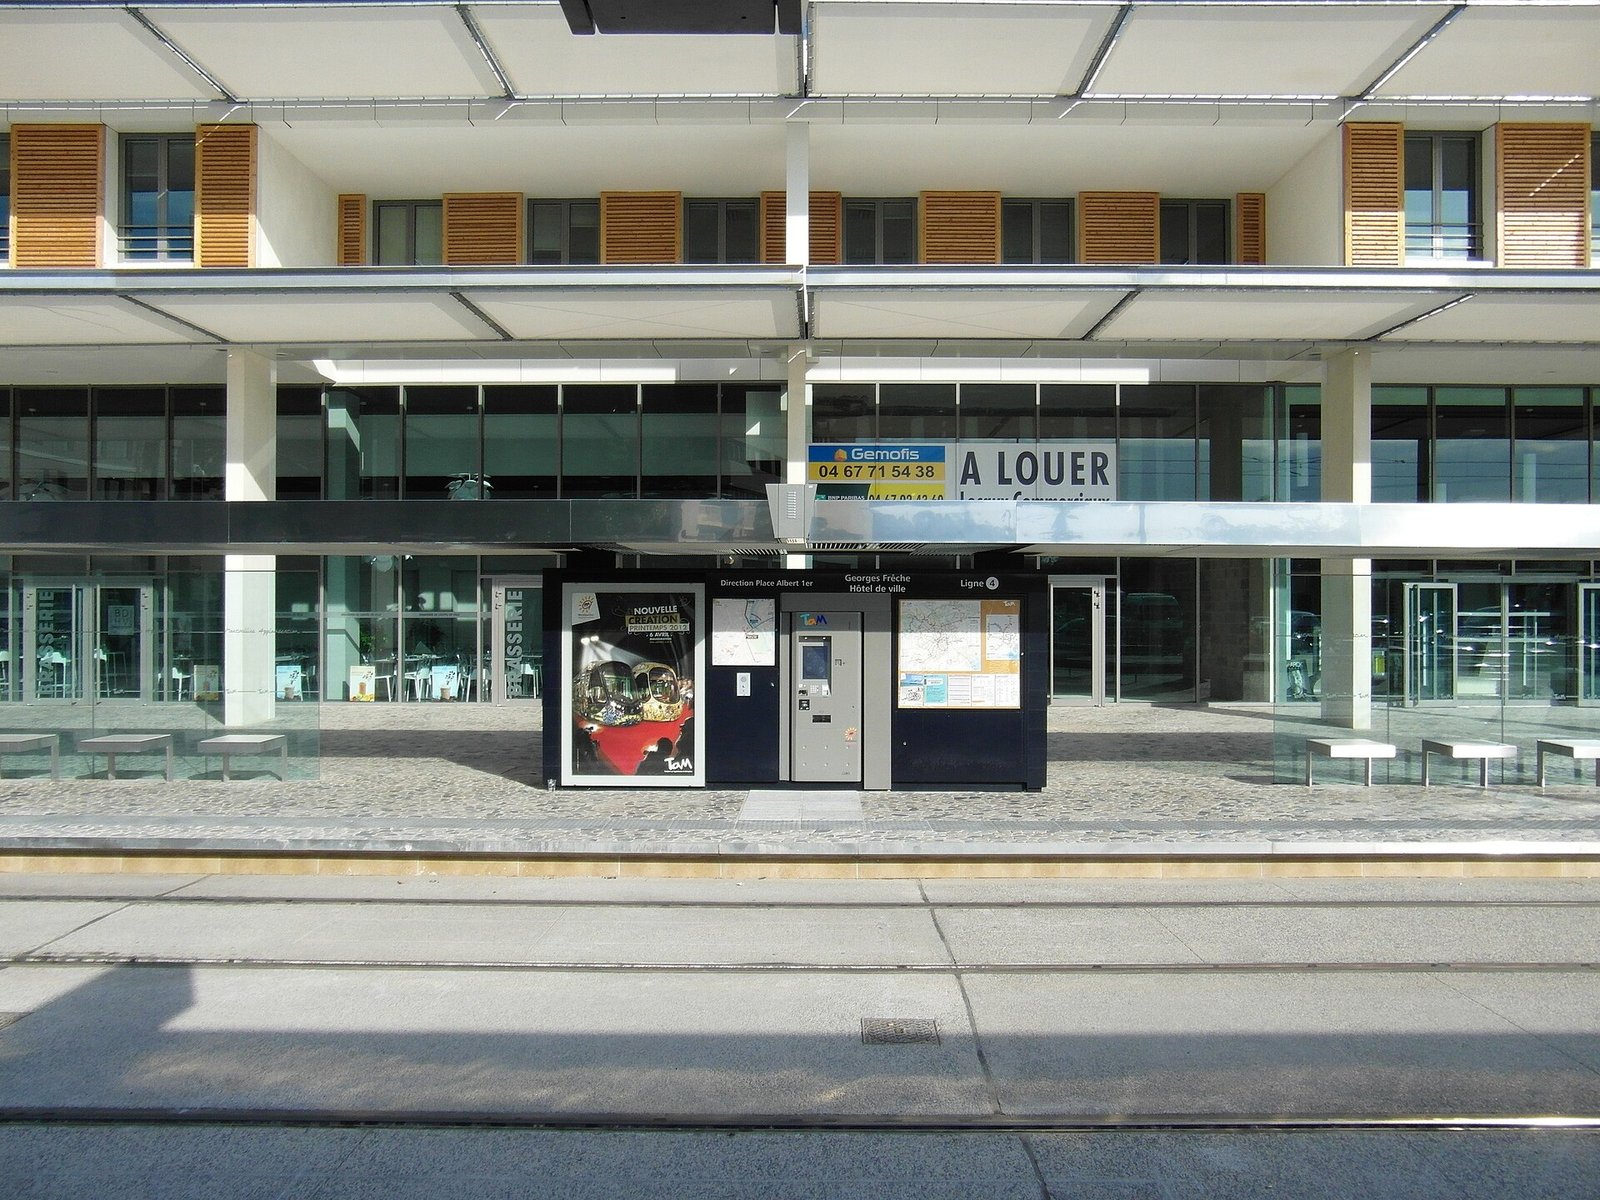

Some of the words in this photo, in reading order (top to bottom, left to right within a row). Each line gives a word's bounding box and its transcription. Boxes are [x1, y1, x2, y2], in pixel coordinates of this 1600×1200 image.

[851, 448, 920, 461] Gemofis
[819, 466, 839, 478] 04
[843, 466, 863, 478] 67
[867, 466, 886, 478] 71
[891, 466, 911, 478] 54
[915, 466, 935, 478] 38
[960, 452, 981, 485] A
[998, 451, 1110, 486] LOUER
[720, 579, 754, 587] Direction
[756, 579, 775, 587] Place
[776, 579, 799, 587] Albert
[801, 579, 813, 587] 1er
[845, 574, 880, 583] Georges
[960, 579, 984, 589] Ligne
[850, 584, 873, 593] Hôtel
[876, 583, 885, 593] de
[888, 583, 906, 593] ville
[634, 605, 677, 615] NOUVELLE
[39, 591, 54, 694] BRASSERIE
[506, 591, 523, 697] BRASSERIE
